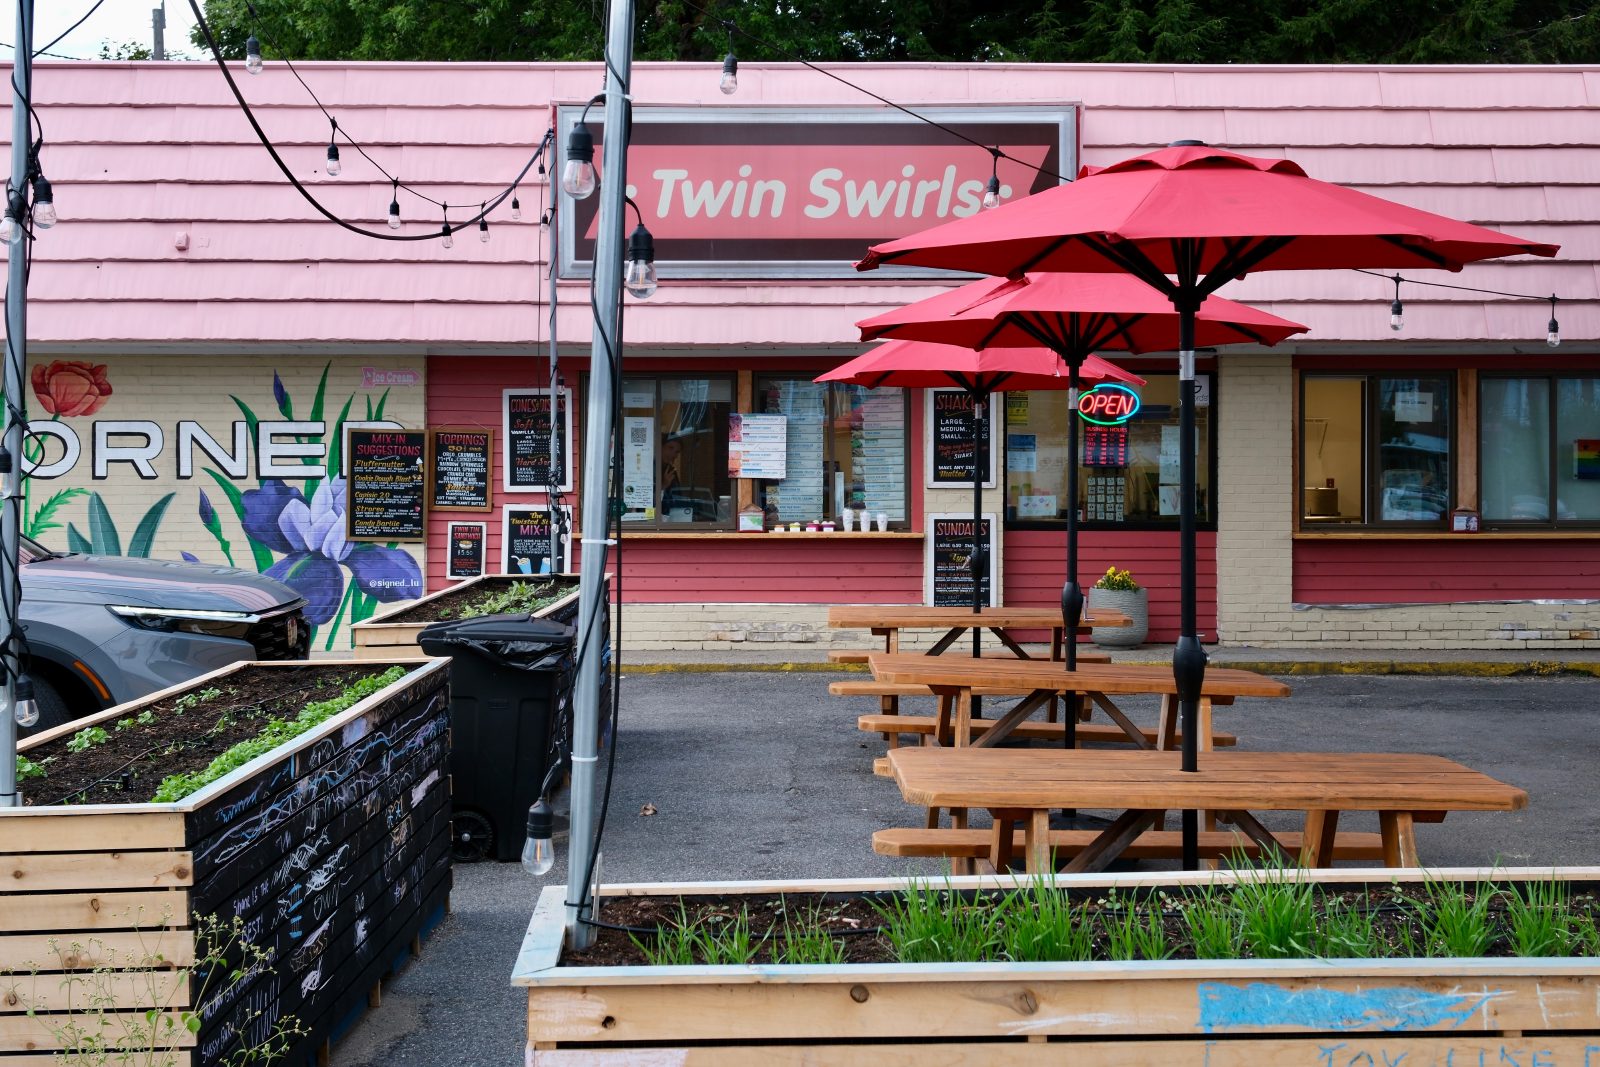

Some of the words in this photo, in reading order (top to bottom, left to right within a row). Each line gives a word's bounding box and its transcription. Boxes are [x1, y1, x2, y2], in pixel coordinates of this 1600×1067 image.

[653, 164, 787, 218] Twin
[803, 164, 984, 218] Swirls
[387, 371, 416, 383] Cream
[511, 398, 536, 412] CONES
[541, 398, 566, 412] DISES
[1079, 394, 1134, 415] OPEN
[371, 434, 406, 444] MIX-IN
[437, 433, 487, 446] TOPPINGS
[357, 444, 421, 456] SUGGESTIONS
[369, 578, 419, 588] @signed_lu
